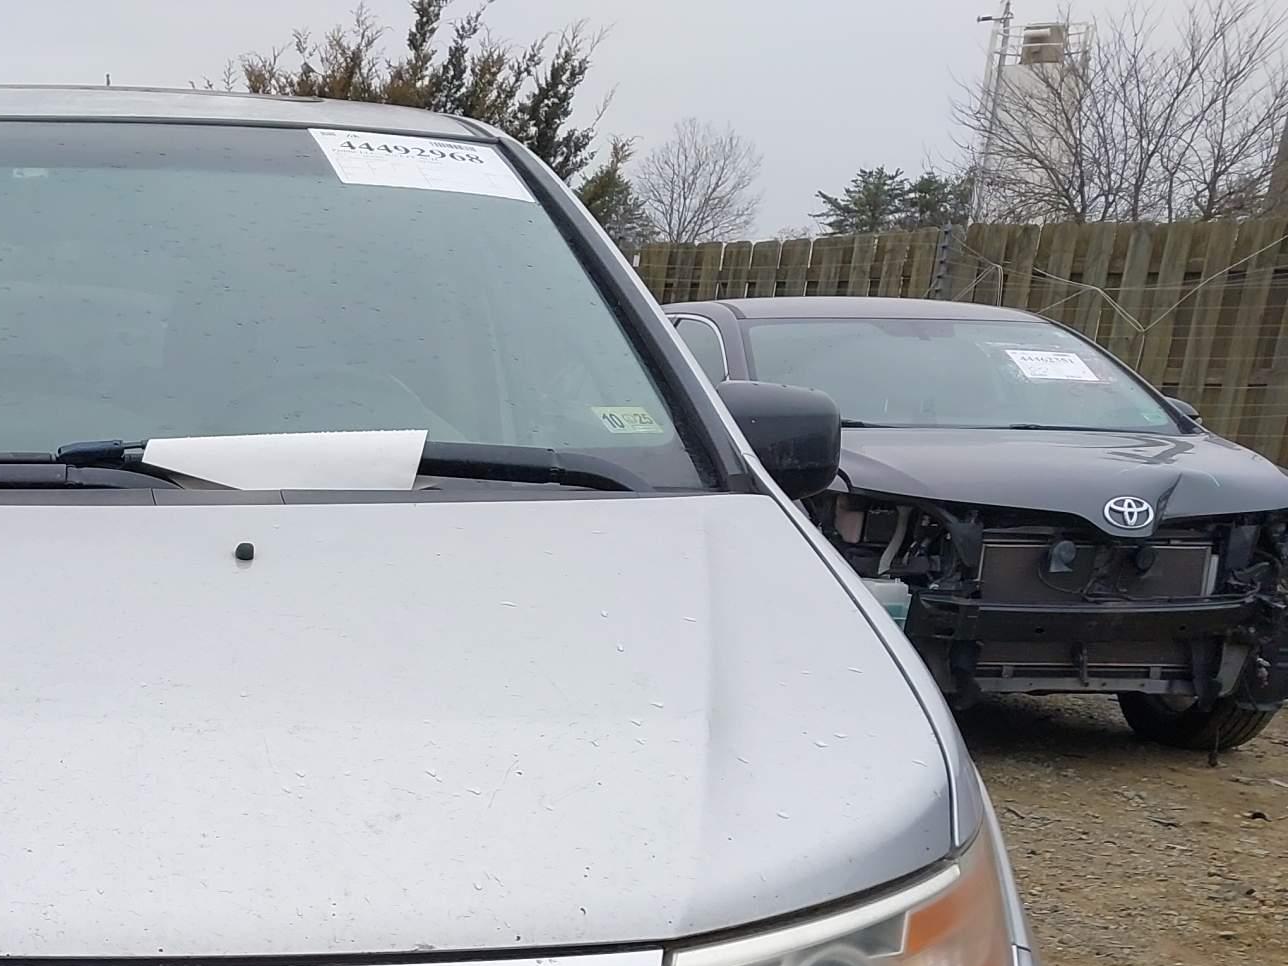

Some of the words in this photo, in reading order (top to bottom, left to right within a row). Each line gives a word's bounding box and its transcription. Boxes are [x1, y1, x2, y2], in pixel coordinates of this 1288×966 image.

[340, 140, 484, 164] 44492968
[602, 412, 624, 429] 10
[632, 413, 654, 425] 25
